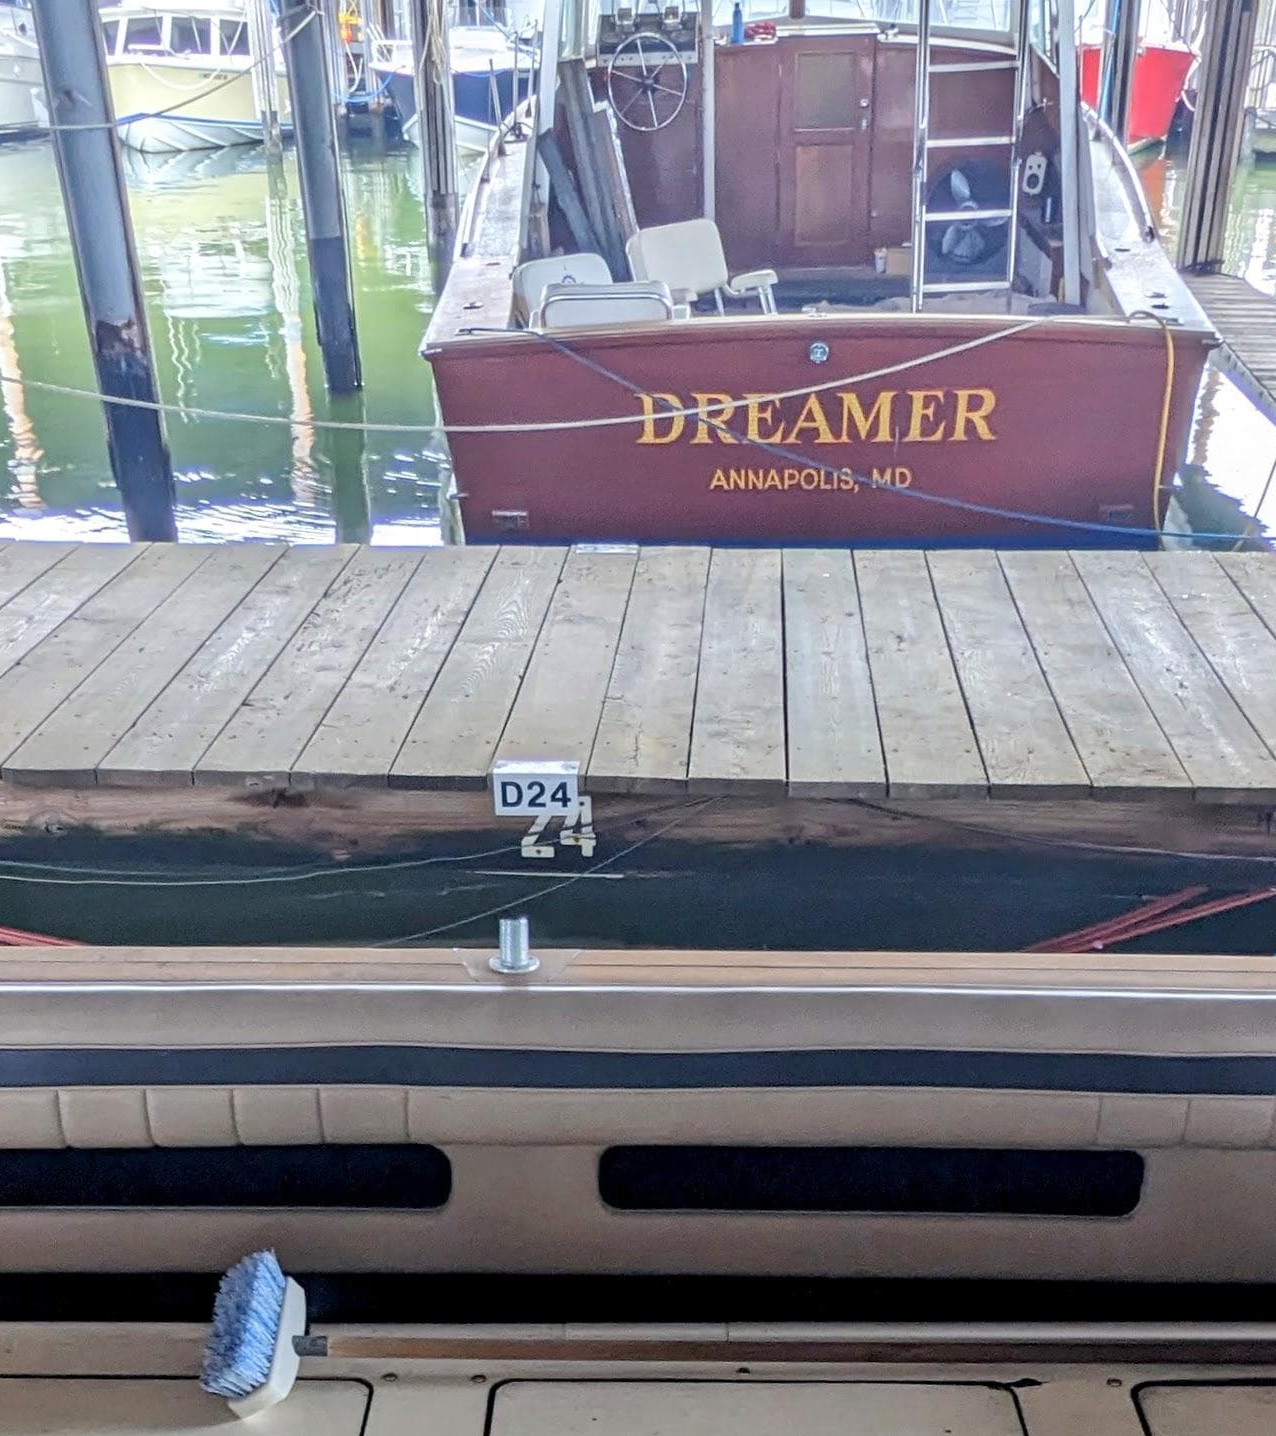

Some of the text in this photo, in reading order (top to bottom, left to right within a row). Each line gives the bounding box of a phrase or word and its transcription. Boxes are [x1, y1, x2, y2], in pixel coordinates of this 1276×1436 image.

[634, 388, 998, 445] DREAMER
[708, 467, 913, 493] ANNAPOLIS, MD
[500, 780, 572, 808] D24
